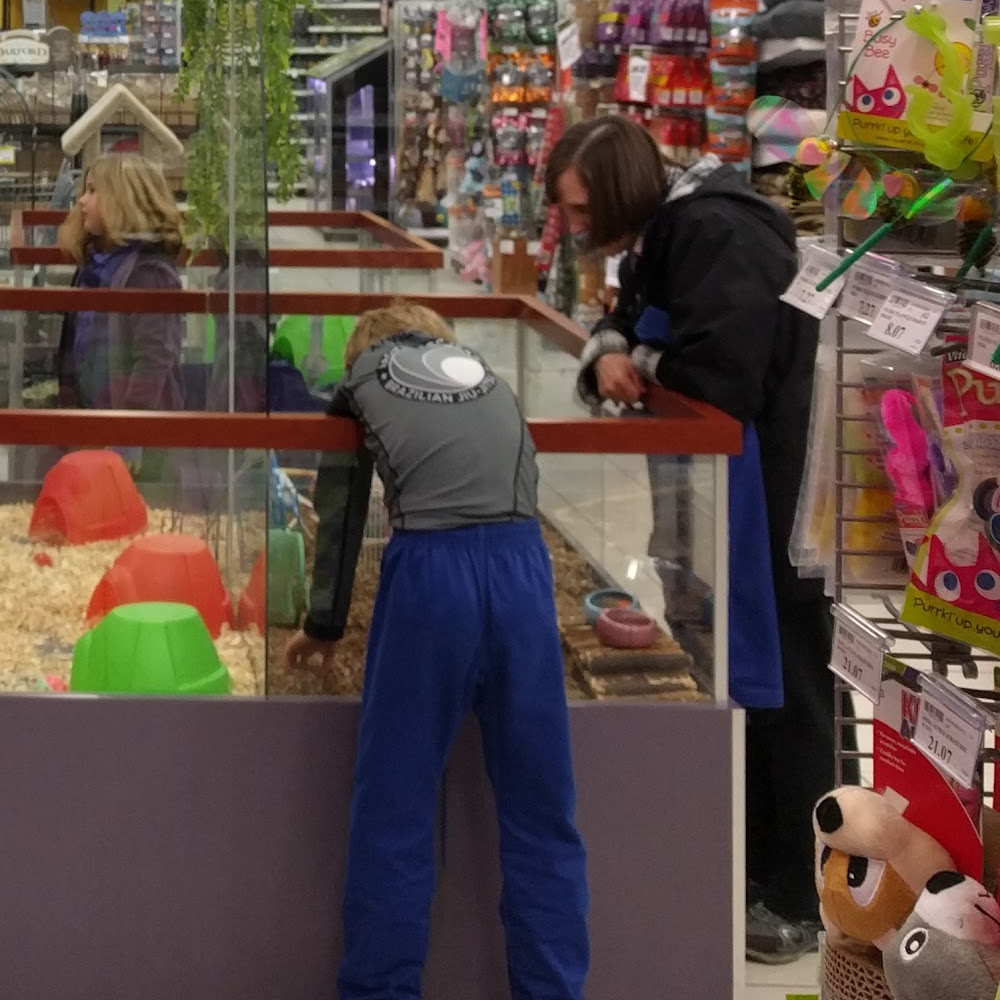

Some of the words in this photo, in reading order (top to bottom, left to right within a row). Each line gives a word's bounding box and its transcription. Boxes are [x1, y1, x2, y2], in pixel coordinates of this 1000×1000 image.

[863, 30, 897, 48] Busy
[863, 46, 891, 59] Bee
[384, 380, 454, 404] BRAZILIAN
[913, 597, 953, 622] Purrk!
[955, 616, 973, 629] up
[842, 656, 863, 680] 21.07
[927, 735, 953, 764] 21.07
